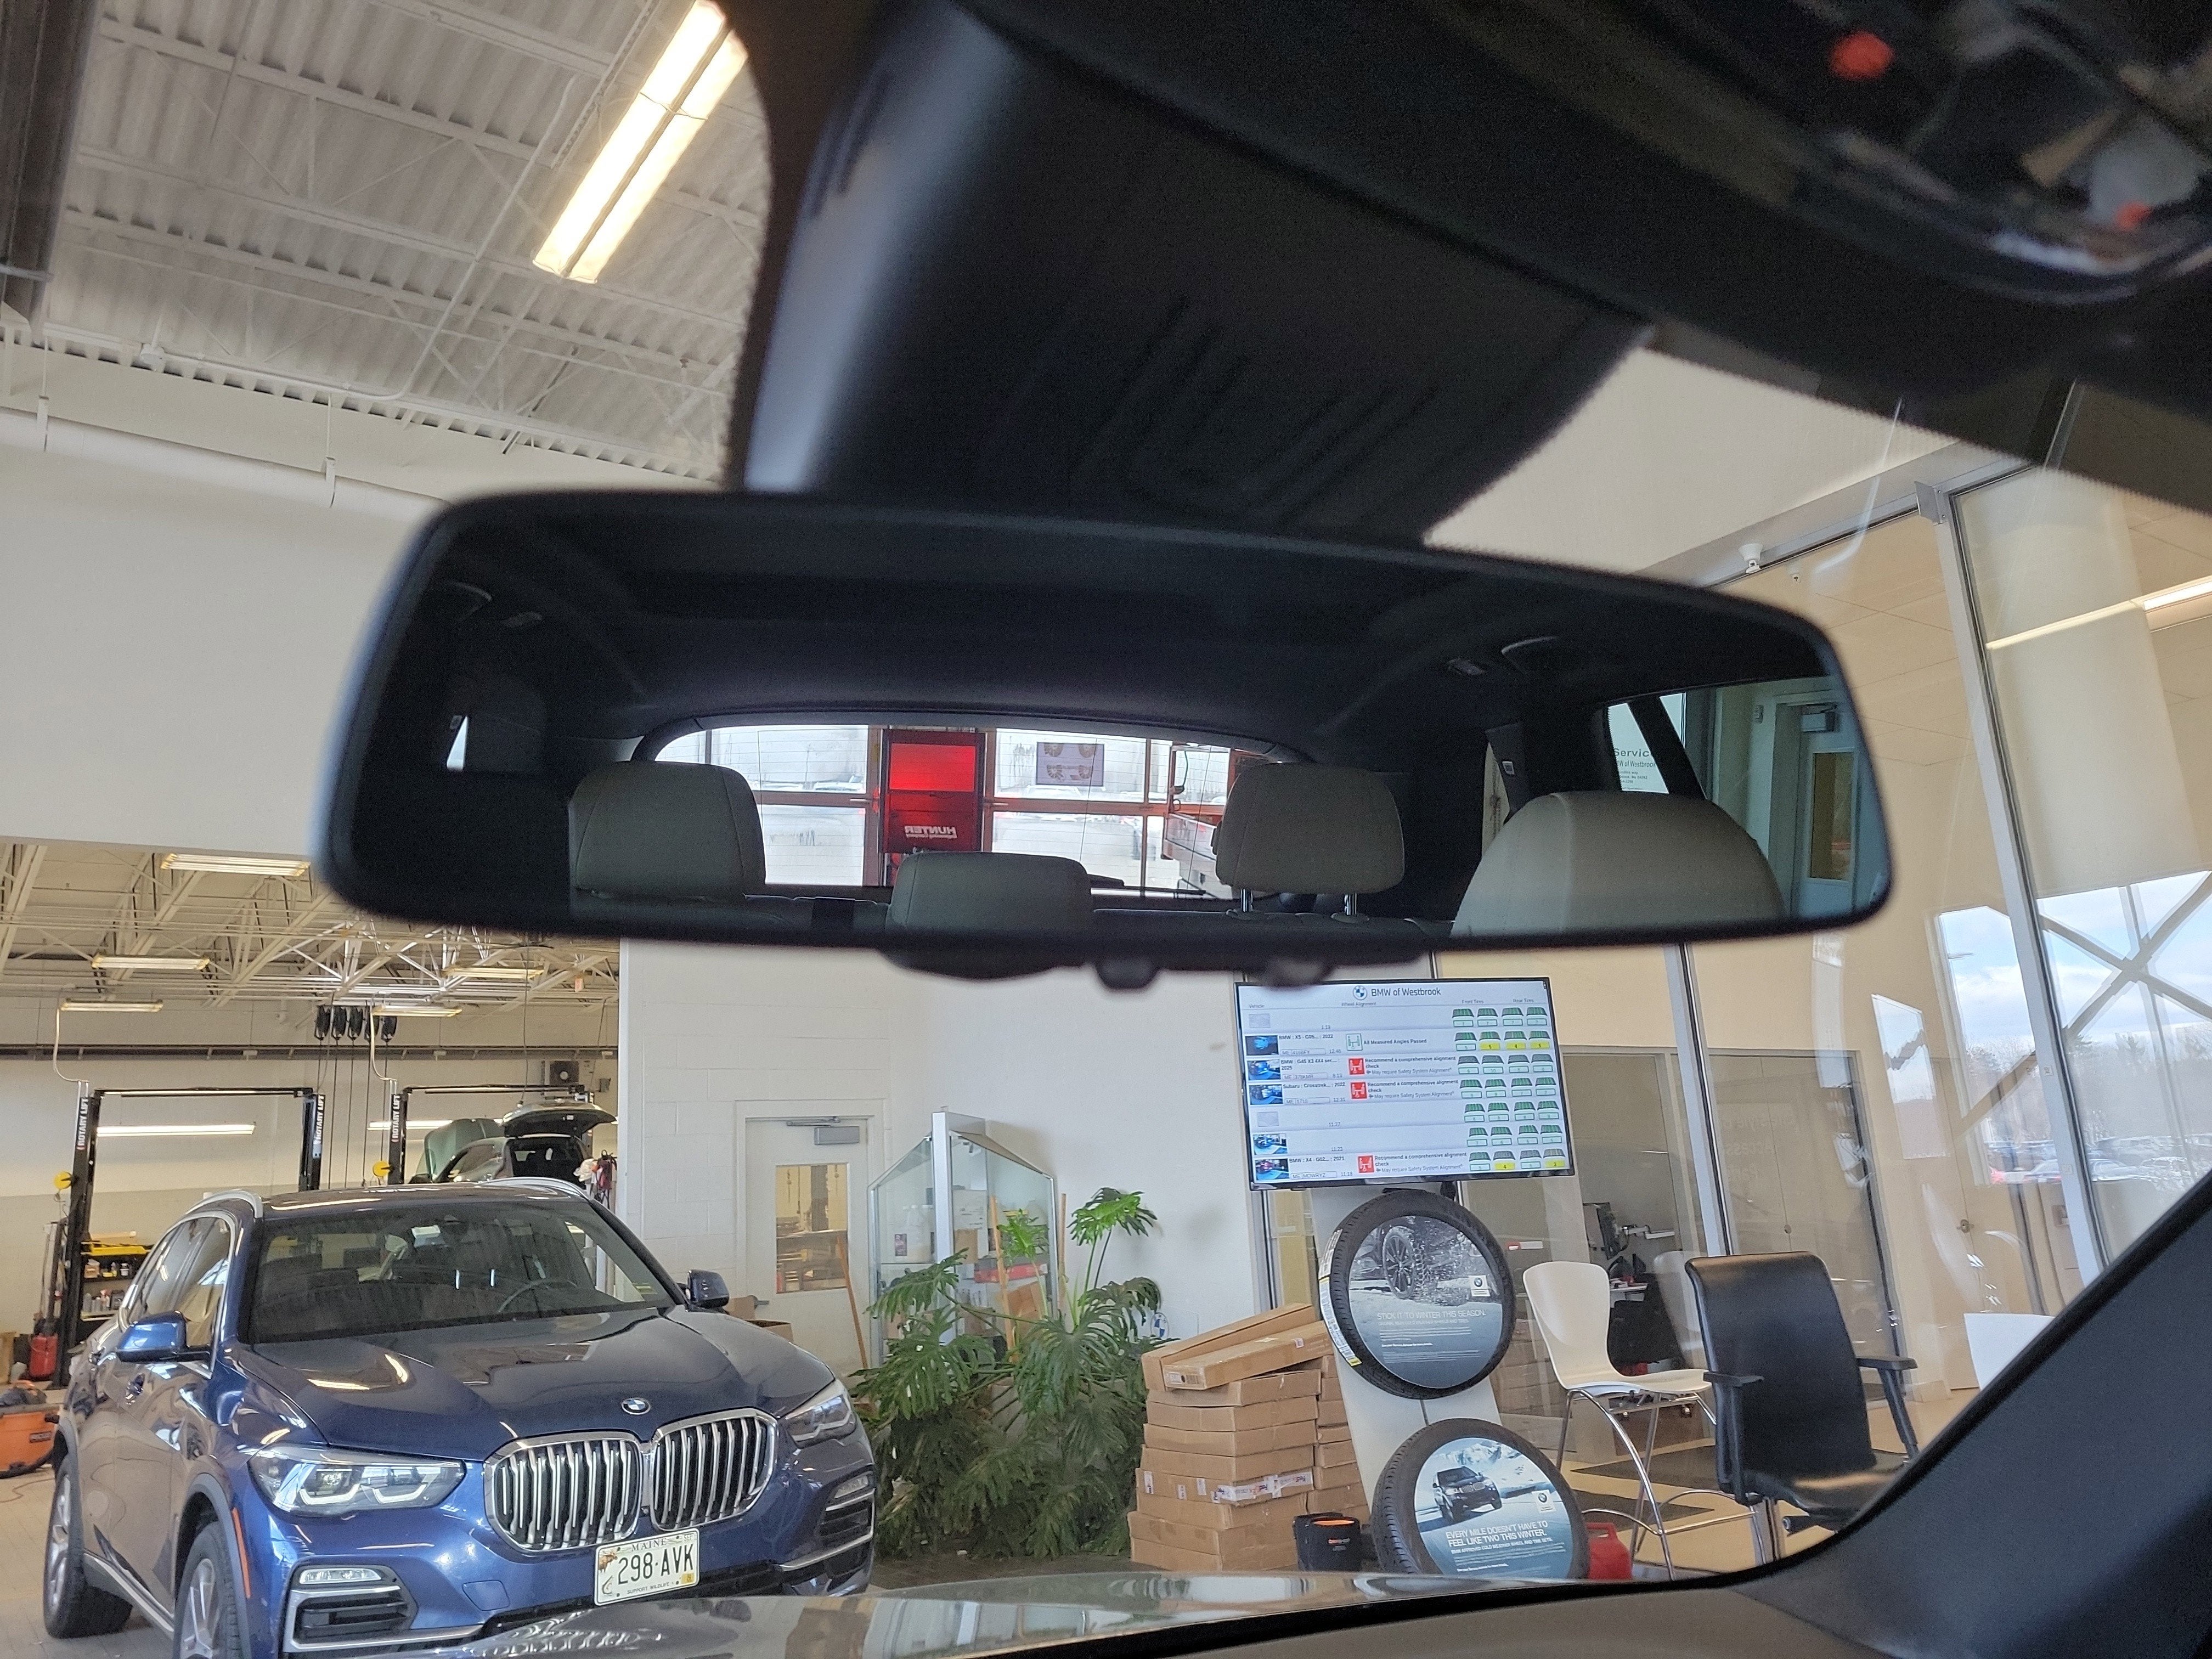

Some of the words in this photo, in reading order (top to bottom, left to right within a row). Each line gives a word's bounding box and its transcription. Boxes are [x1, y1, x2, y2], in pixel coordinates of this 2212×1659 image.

[1614, 748, 1651, 757] Servic
[1371, 988, 1391, 997] BMW
[1393, 988, 1401, 996] of
[1402, 987, 1441, 996] Westbrook
[1446, 1529, 1469, 1539] EVERY
[1469, 1528, 1487, 1537] MILE
[1487, 1524, 1517, 1536] DOESN'T
[1517, 1522, 1537, 1531] HAVE
[1538, 1520, 1548, 1528] TO
[631, 1538, 668, 1553] MAINE
[1448, 1538, 1467, 1548] FEEL
[1466, 1536, 1483, 1545] LIKE
[1485, 1534, 1500, 1543] TWO
[1500, 1532, 1517, 1542] THIS
[627, 1585, 648, 1595] SUPPORT
[650, 1582, 670, 1590] WILDLIFE
